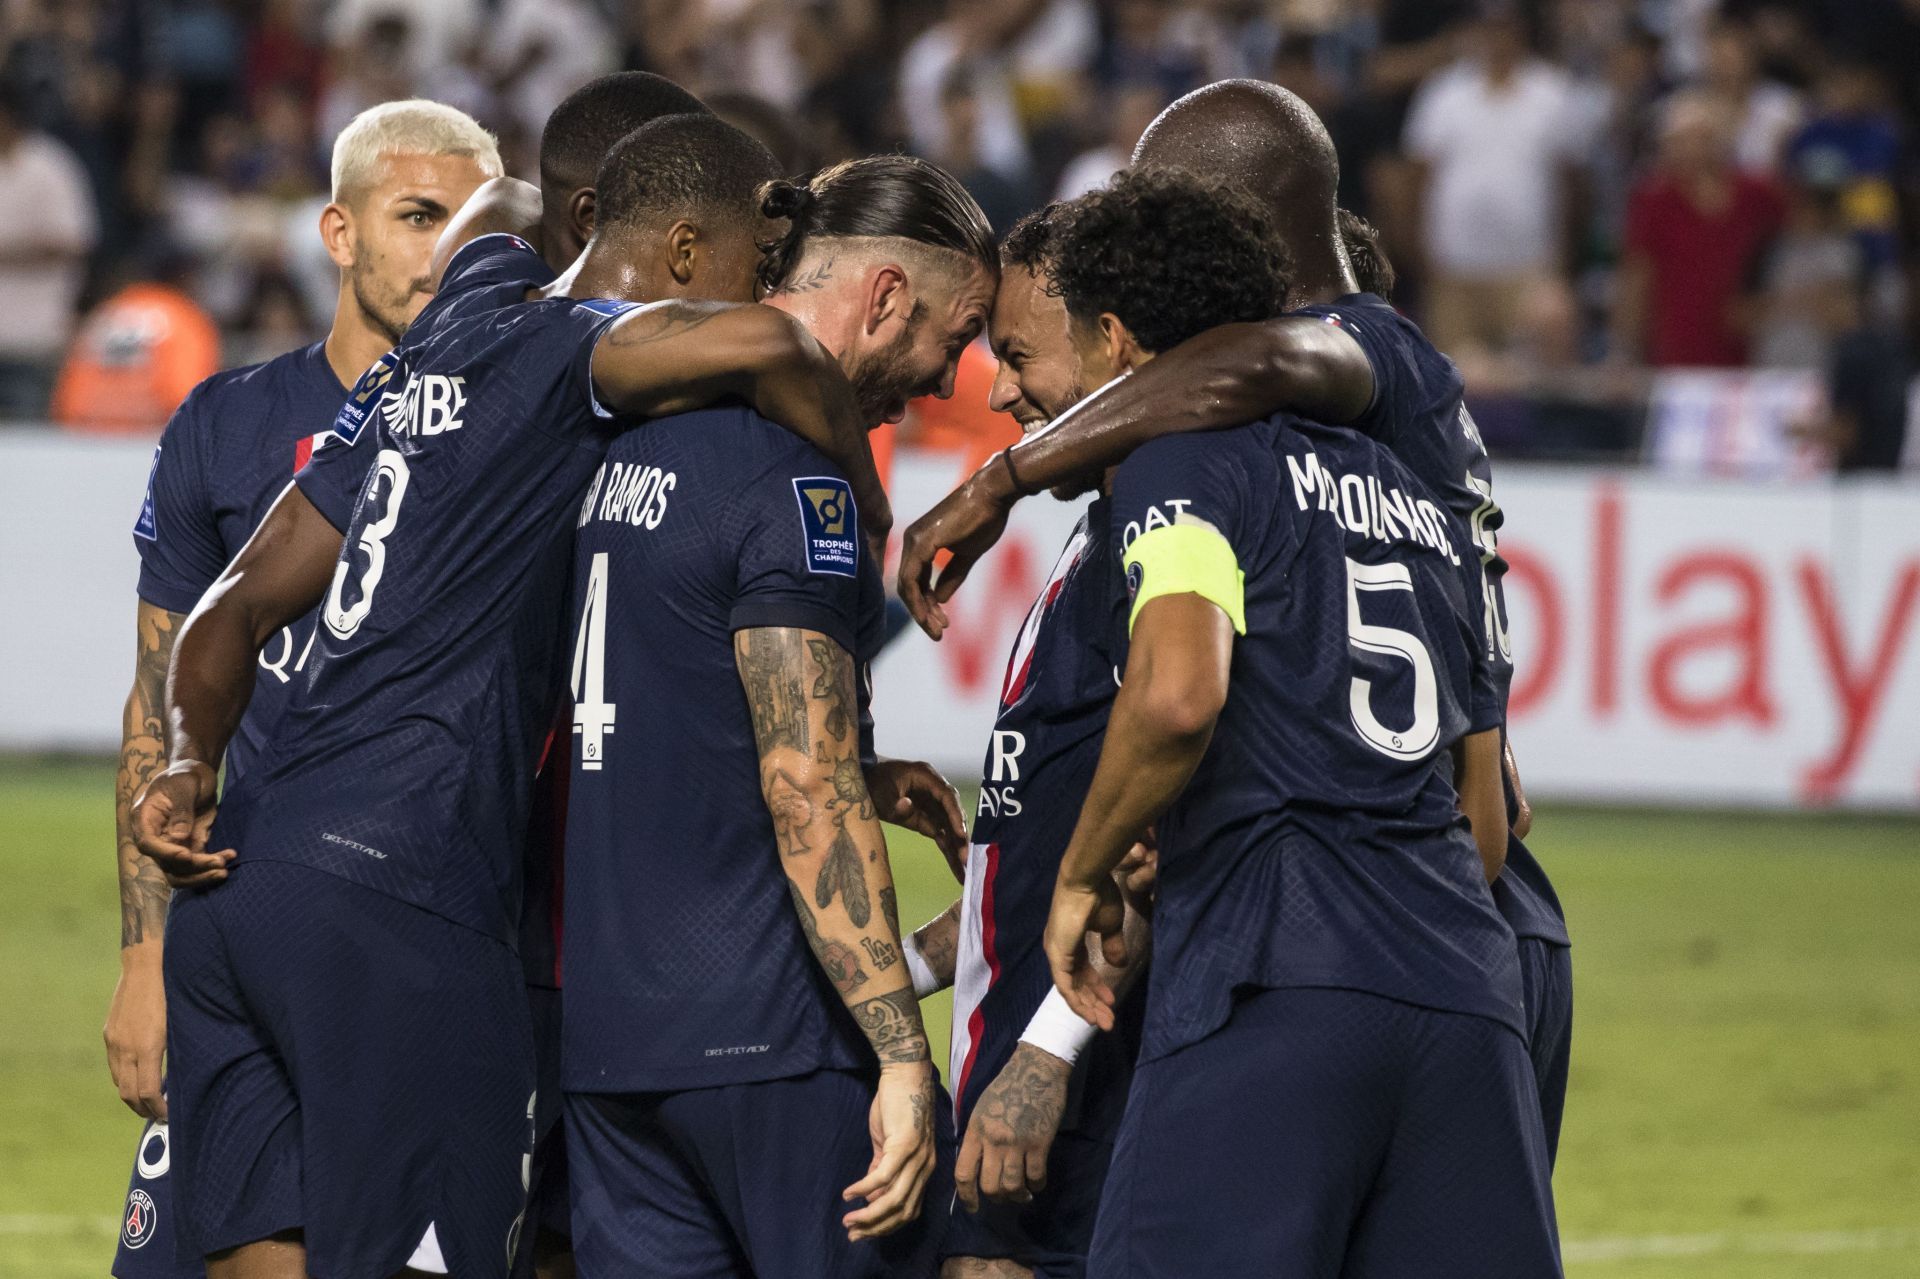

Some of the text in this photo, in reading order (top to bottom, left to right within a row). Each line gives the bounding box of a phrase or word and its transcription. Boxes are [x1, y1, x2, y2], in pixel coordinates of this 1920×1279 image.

[599, 462, 677, 530] RAMOS
[325, 449, 410, 640] 3
[812, 539, 854, 551] TROPHÉE
[814, 554, 854, 565] CHAMPIONS
[829, 548, 842, 556] DES
[570, 552, 616, 770] 4
[1345, 555, 1440, 762] 5
[130, 1192, 152, 1211] PARIS
